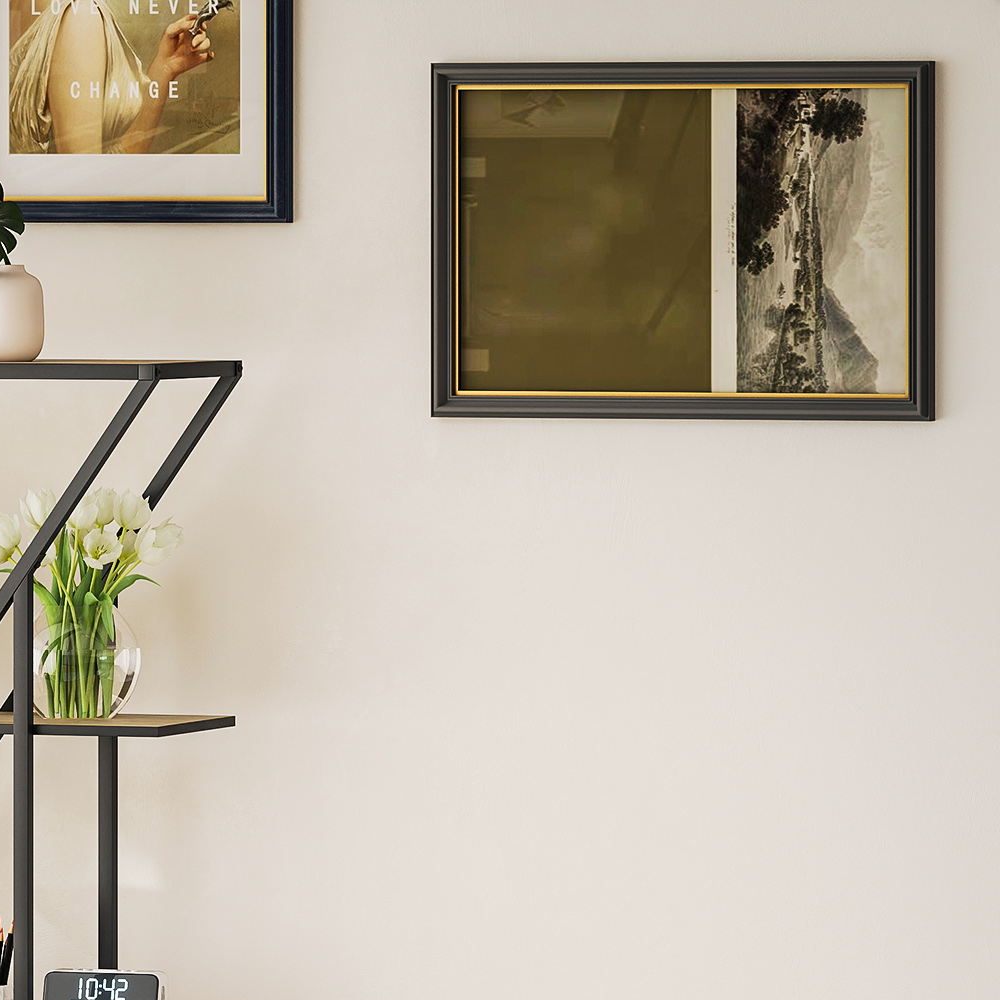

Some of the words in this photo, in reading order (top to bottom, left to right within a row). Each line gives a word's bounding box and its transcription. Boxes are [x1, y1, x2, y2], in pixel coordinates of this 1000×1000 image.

[31, 0, 100, 15] LOVE
[129, 0, 219, 15] NEVER
[70, 81, 179, 99] CHANGE
[78, 977, 129, 1000] 10:42
